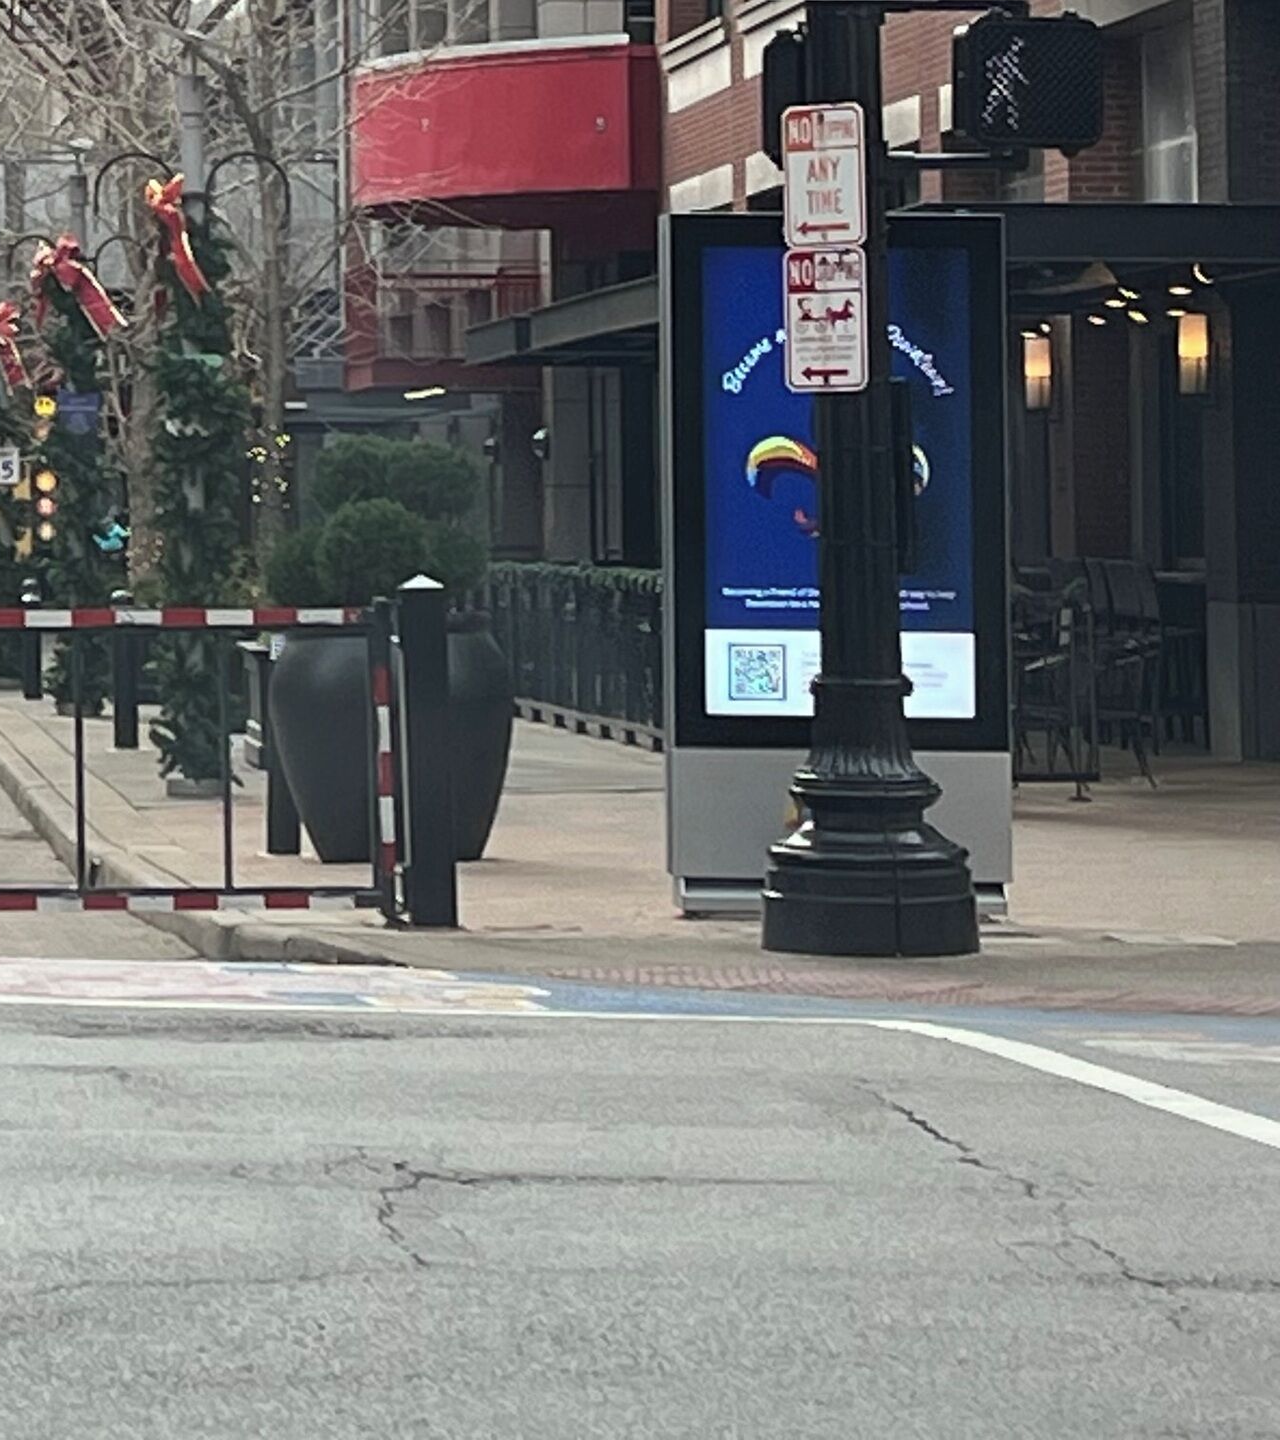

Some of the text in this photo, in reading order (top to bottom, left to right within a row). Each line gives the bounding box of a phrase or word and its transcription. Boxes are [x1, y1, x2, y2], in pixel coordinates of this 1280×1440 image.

[787, 116, 812, 145] NO
[806, 156, 841, 183] ANY
[806, 188, 844, 216] TIME
[788, 258, 814, 287] NO
